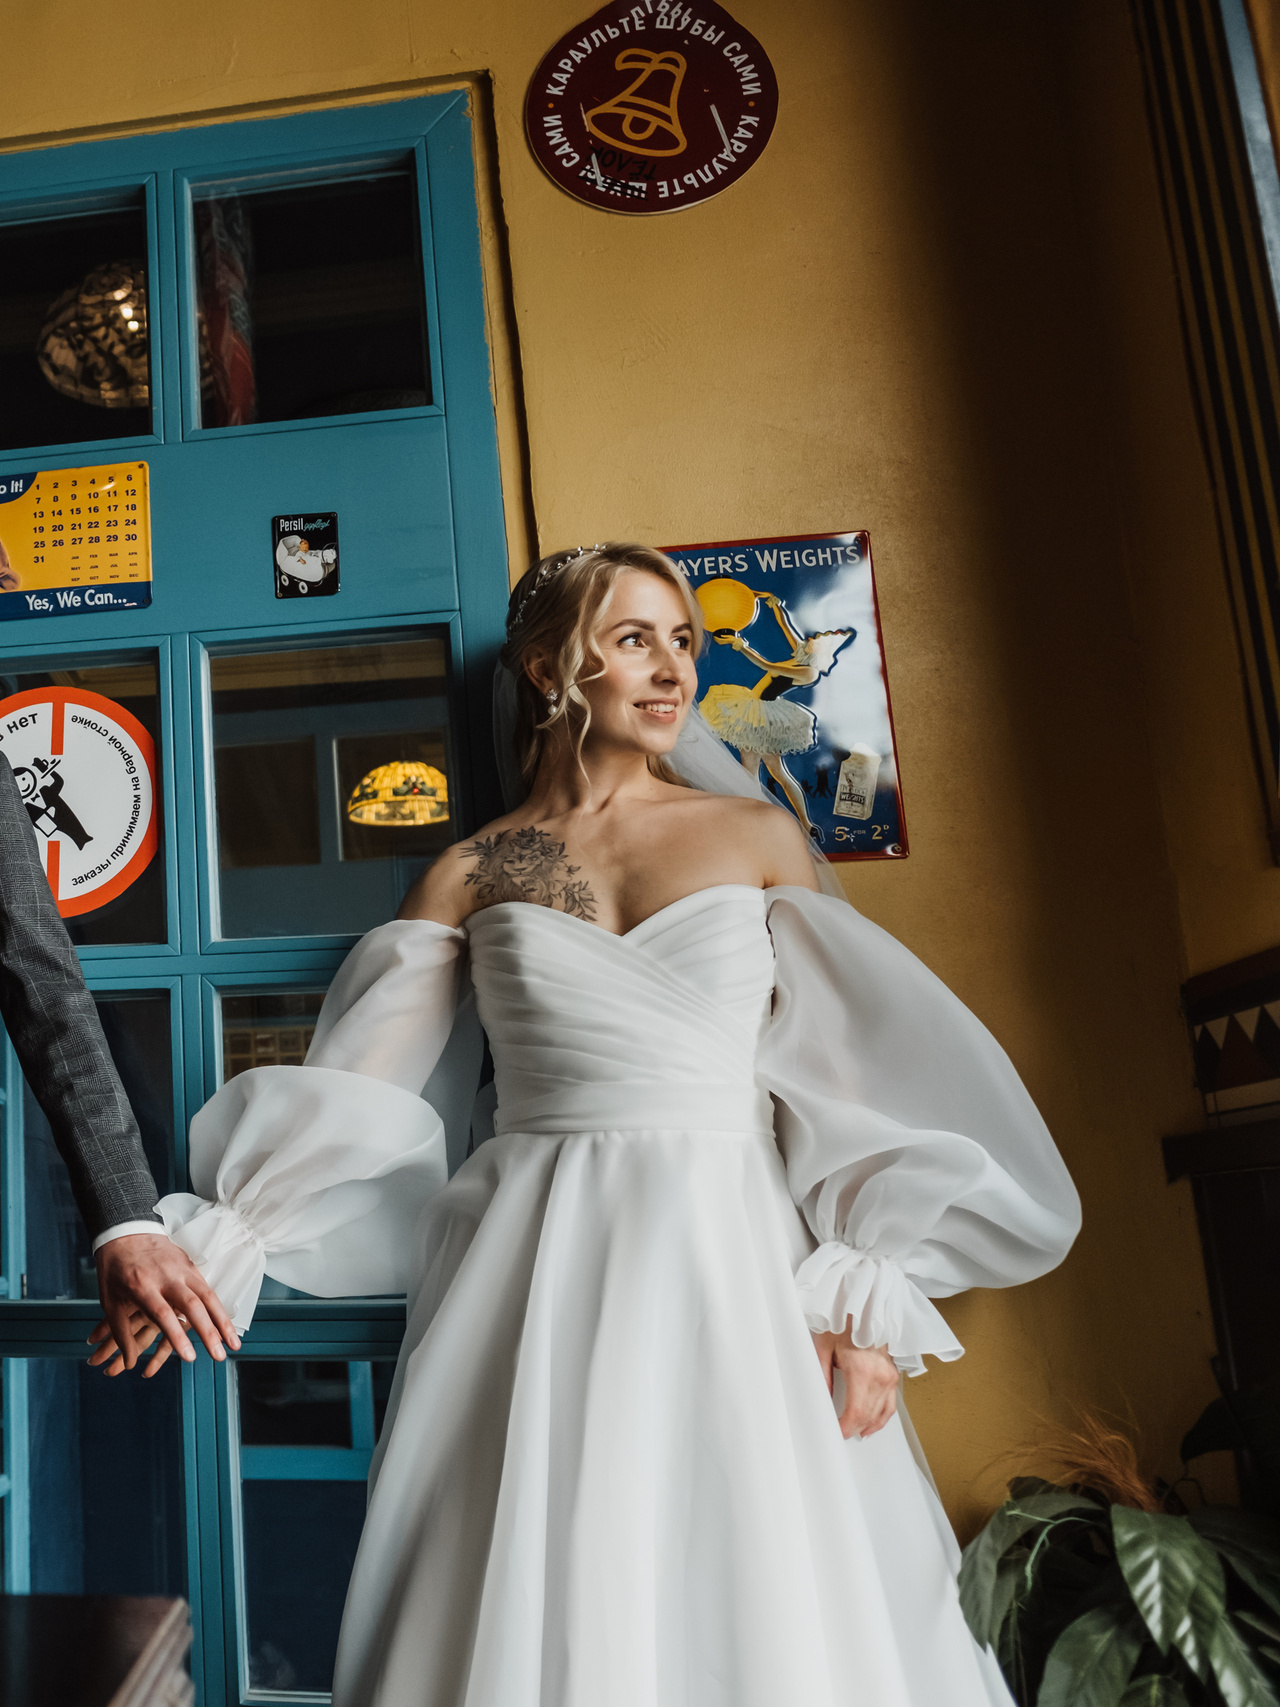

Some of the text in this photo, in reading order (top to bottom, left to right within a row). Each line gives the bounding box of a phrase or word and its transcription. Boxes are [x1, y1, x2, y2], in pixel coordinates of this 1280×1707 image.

[546, 12, 762, 96] КАРАУЛЬТЕ ШУБЫ САМИ
[542, 114, 581, 168] САМИ
[657, 114, 760, 198] КАРАУЛЬТЕ
[10, 479, 23, 493] It!
[51, 509, 62, 517] 14
[107, 504, 118, 512] 17
[52, 524, 64, 532] 20
[280, 518, 303, 531] Persil
[52, 539, 64, 547] 26
[71, 537, 83, 545] 27
[106, 534, 118, 542] 29
[125, 533, 137, 541] 30
[677, 553, 748, 577] AYER'S
[25, 589, 127, 611] Yes, We Can...
[6, 713, 38, 733] нет
[71, 715, 141, 886] заказы принимаем на барной стойке
[834, 826, 849, 841] 5
